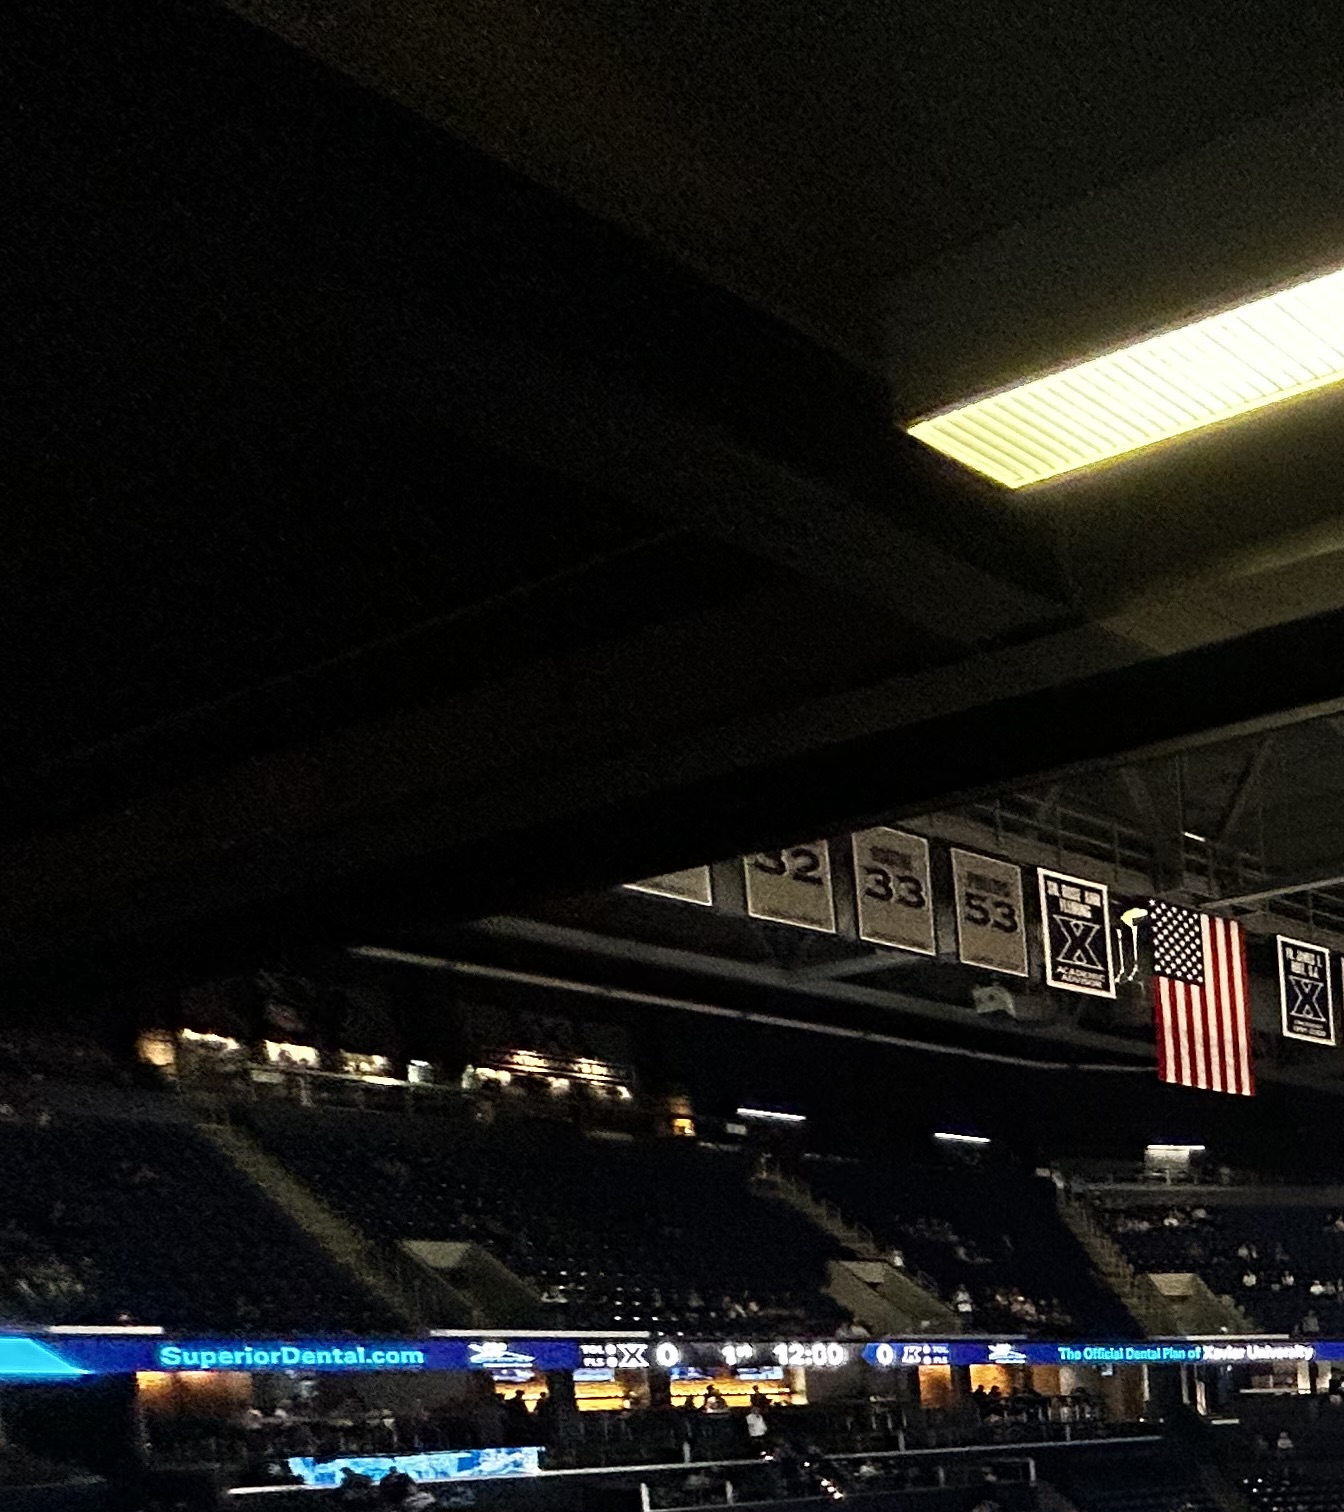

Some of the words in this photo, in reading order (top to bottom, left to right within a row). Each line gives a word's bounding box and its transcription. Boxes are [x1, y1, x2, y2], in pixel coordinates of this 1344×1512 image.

[864, 867, 926, 909] 33
[965, 892, 1018, 934] 53
[159, 1344, 425, 1369] SuperiorDental.com
[618, 1343, 649, 1367] X
[656, 1343, 679, 1366] 0
[774, 1343, 845, 1367] 12:00
[876, 1343, 893, 1365] 0
[1058, 1346, 1081, 1360] The
[1083, 1346, 1123, 1361] Official
[1125, 1346, 1160, 1361] Dental
[1162, 1346, 1186, 1361] Plan
[1188, 1346, 1201, 1361] of
[1202, 1346, 1244, 1361] Xavier
[1246, 1345, 1314, 1362] University
